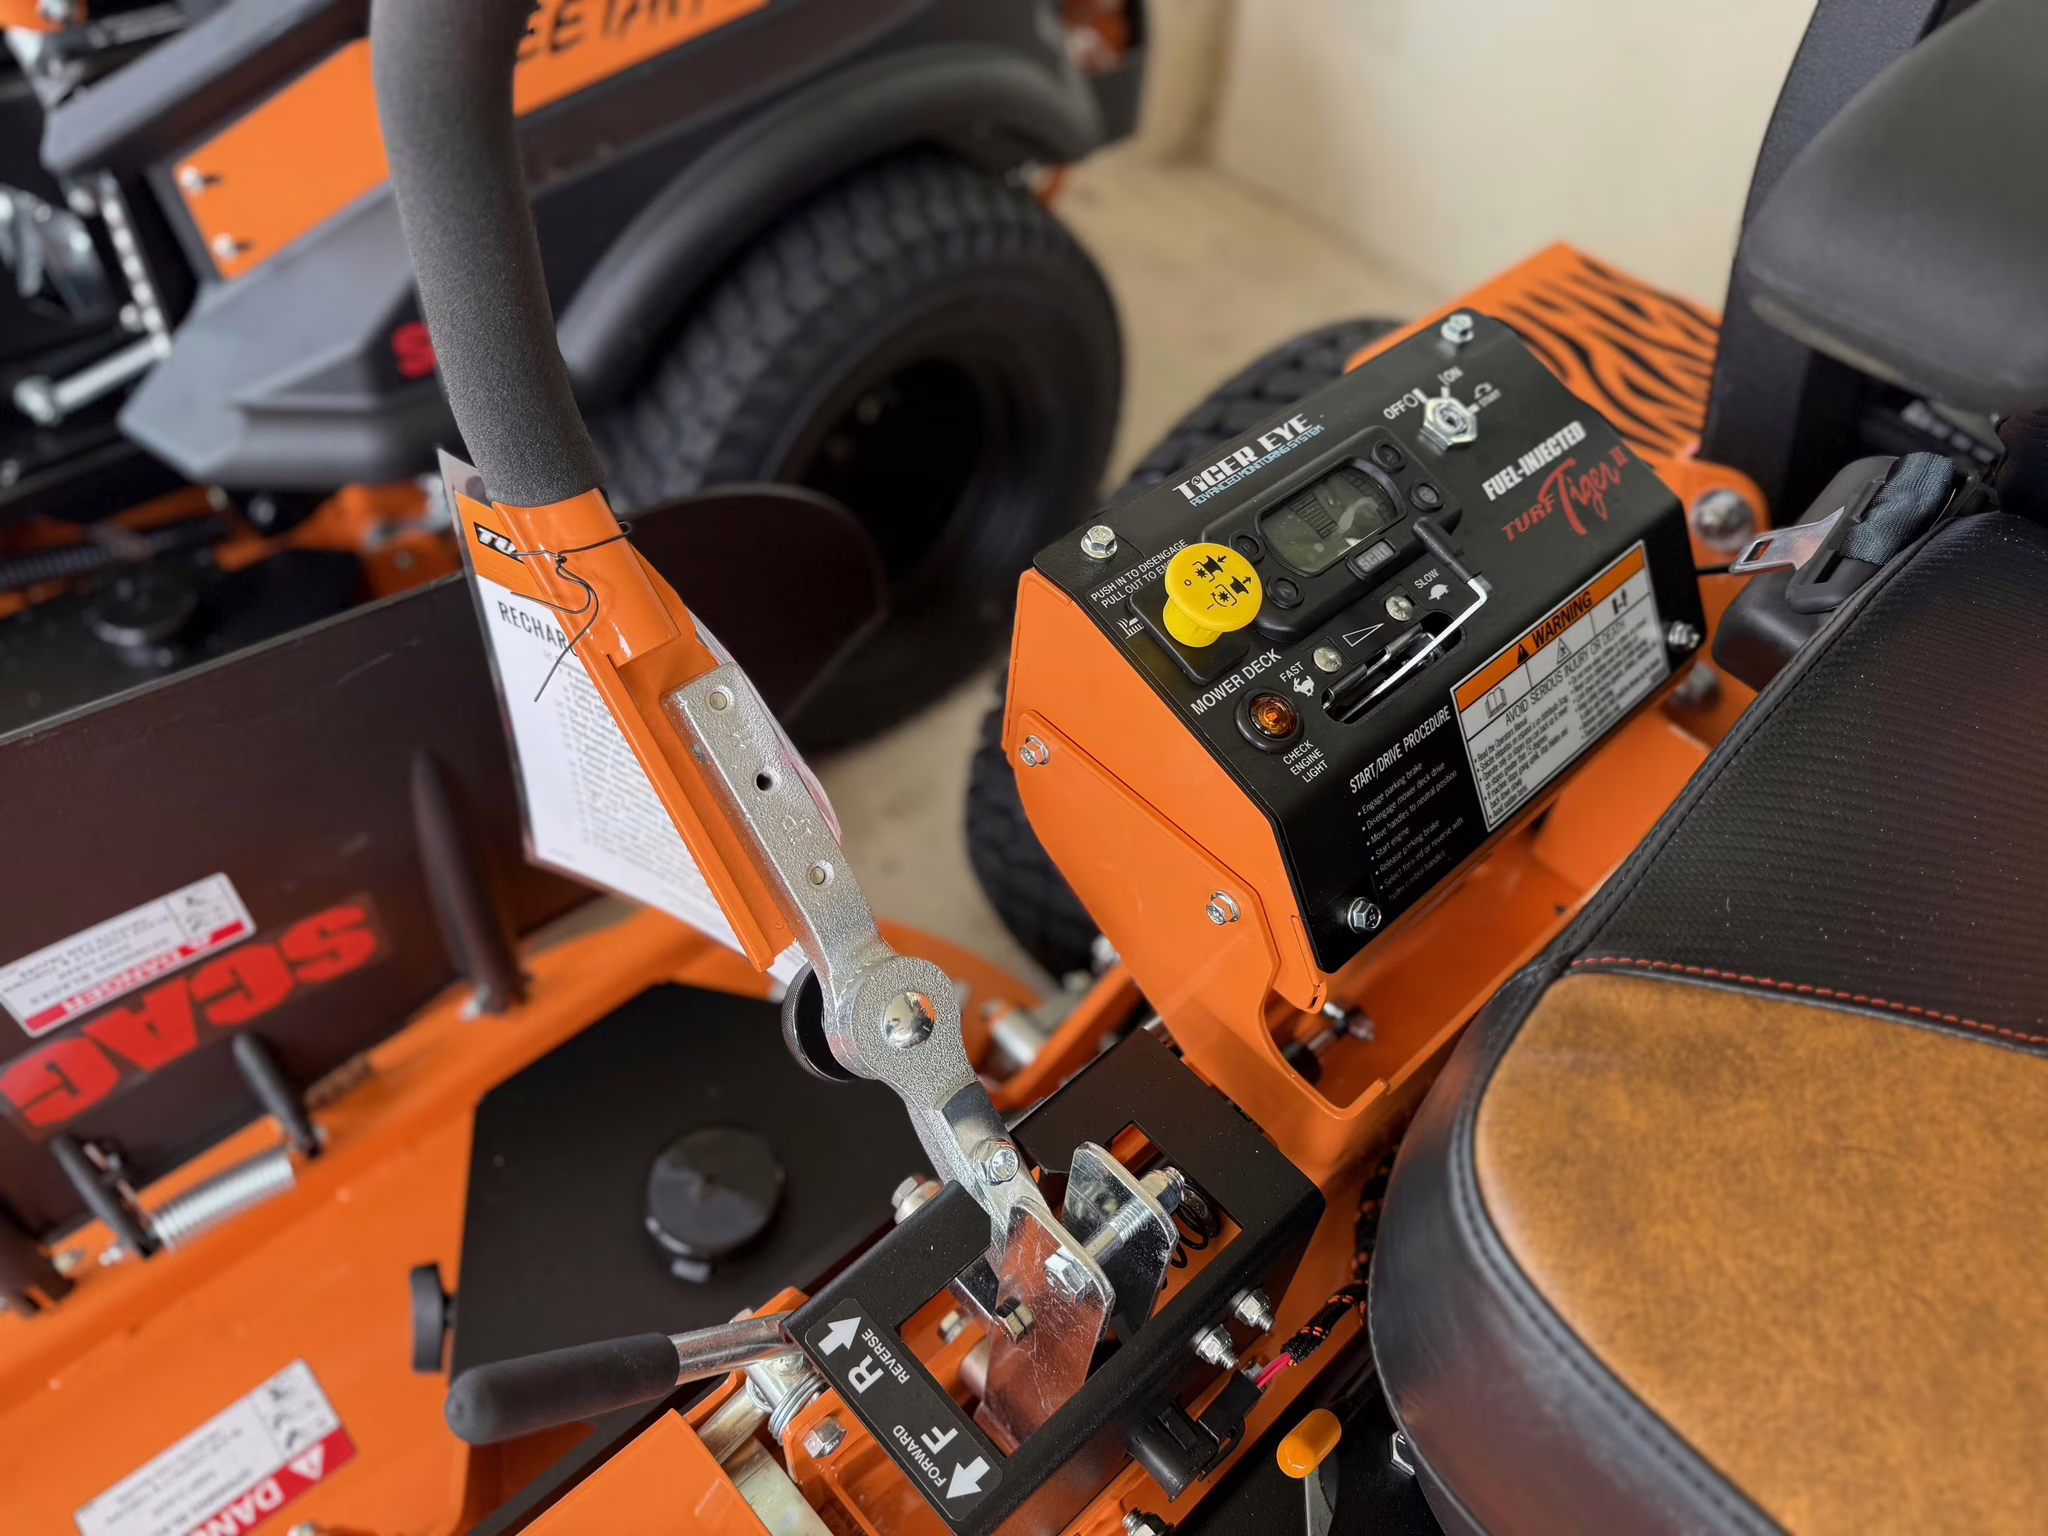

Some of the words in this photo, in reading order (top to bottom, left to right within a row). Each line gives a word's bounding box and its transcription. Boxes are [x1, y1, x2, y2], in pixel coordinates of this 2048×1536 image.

[1443, 366, 1463, 382] ON
[1256, 413, 1313, 452] EYE
[1383, 400, 1406, 420] OFF
[1189, 473, 1242, 507] ADVANCED
[1240, 446, 1290, 479] MONITORING
[1288, 424, 1325, 450] SYSTEM
[1481, 420, 1587, 501] FUEL-INJECTED
[1501, 494, 1555, 542] TURF
[1537, 457, 1621, 536] Tiger
[1090, 582, 1117, 602] PUSH
[1115, 576, 1128, 587] IN
[1125, 568, 1140, 580] TO
[1138, 539, 1188, 573] DISENGAGE
[1101, 591, 1126, 608] PULL
[1124, 578, 1144, 594] OUT
[1142, 570, 1157, 582] TO
[1414, 568, 1439, 589] SLOW
[1532, 590, 1592, 649] WARNING
[1190, 669, 1246, 716] MOWER
[1241, 648, 1283, 682] DECK
[1279, 661, 1304, 683] FAST
[1504, 698, 1528, 726] AVOID
[1530, 670, 1562, 705] SERIOUS
[1564, 648, 1588, 677] INJURY
[1282, 739, 1314, 765] CHECK
[1289, 748, 1324, 776] ENGINE
[1301, 759, 1328, 783] LIGHT
[1349, 742, 1403, 794] START/DRIVE
[1402, 705, 1451, 753] PROCEDURE
[1362, 792, 1384, 814] Engage
[1385, 775, 1407, 801] parking
[1405, 762, 1423, 784] brake
[1366, 802, 1397, 830] Disengage
[1397, 787, 1416, 806] mower
[1415, 774, 1429, 794] deck
[1430, 762, 1446, 783] drive
[1370, 827, 1387, 844] Move
[1386, 809, 1409, 836] handles
[1409, 803, 1417, 815] to
[1416, 787, 1436, 808] neutral
[1435, 770, 1458, 798] position
[1375, 842, 1391, 859] Start
[1390, 826, 1410, 847] engine
[1379, 850, 1402, 873] Release
[1423, 819, 1441, 838] brake
[1383, 866, 1402, 887] Select
[1431, 828, 1452, 849] reverse
[0, 905, 377, 1127] SCAG
[848, 1354, 884, 1394] R
[861, 1328, 911, 1385] REVERSE
[892, 1424, 948, 1487] FORWARD
[920, 1426, 959, 1455] F
